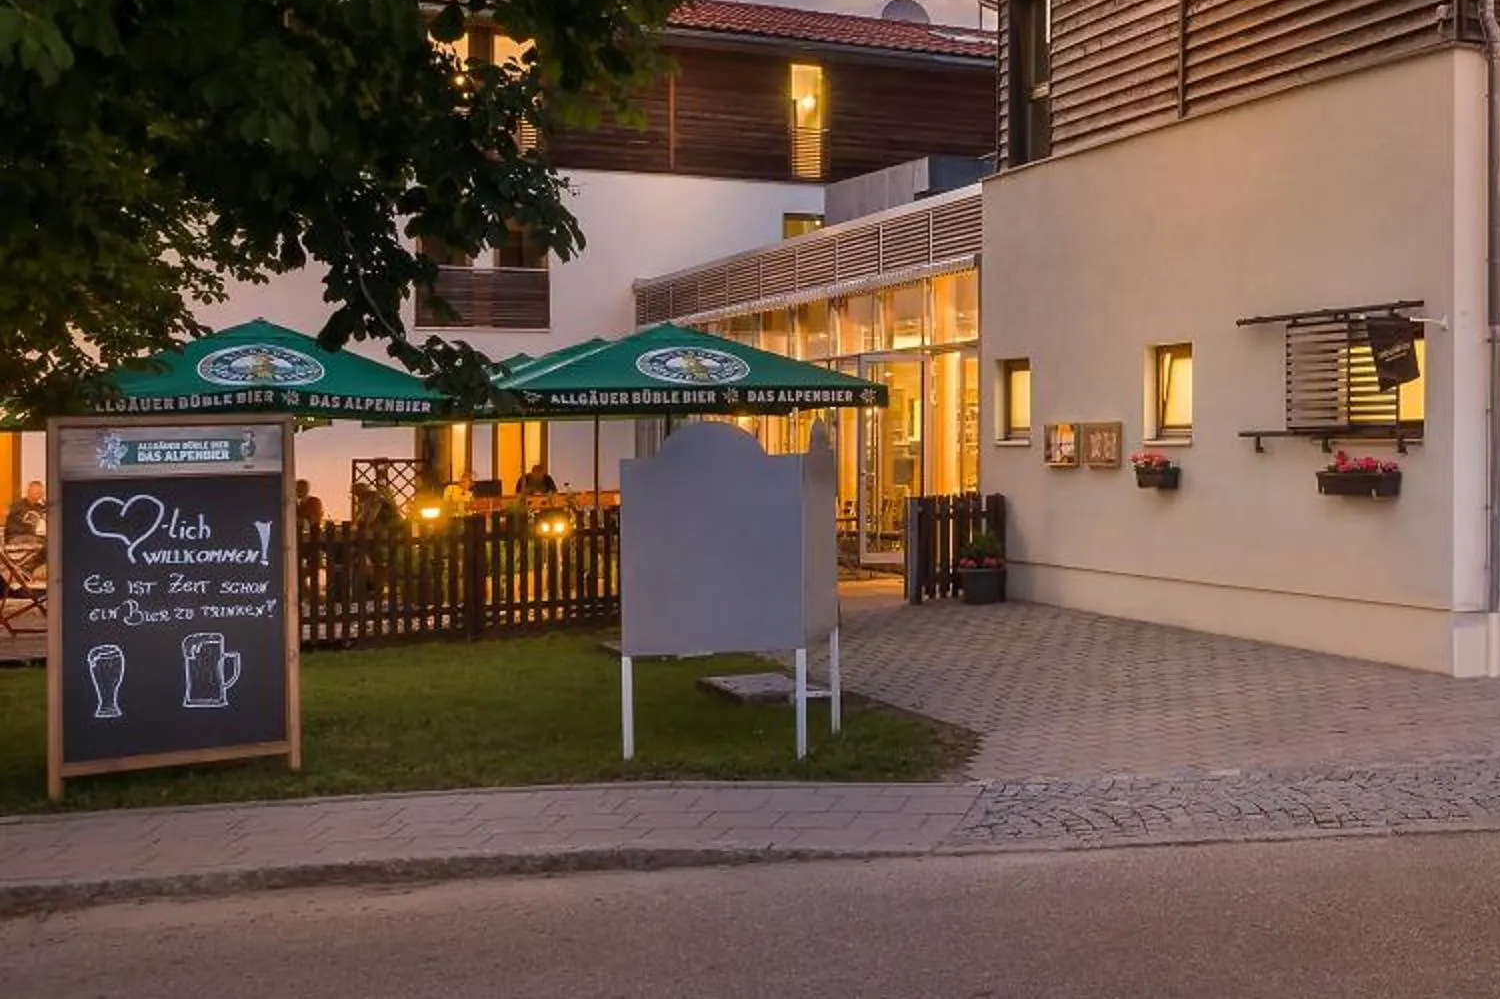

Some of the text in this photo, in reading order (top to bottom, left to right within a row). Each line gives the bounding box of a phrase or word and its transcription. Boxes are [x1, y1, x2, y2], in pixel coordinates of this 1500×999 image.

[85, 396, 175, 413] LLGÄUER
[236, 389, 275, 405] BIER
[308, 394, 341, 409] DAS
[344, 396, 432, 413] ALPENBIER
[550, 389, 853, 406] ALLGÄUER BÜBLE BIER DAS ALPENBIER
[137, 450, 163, 462] DAS
[142, 520, 273, 566] WILLKOMMEN!
